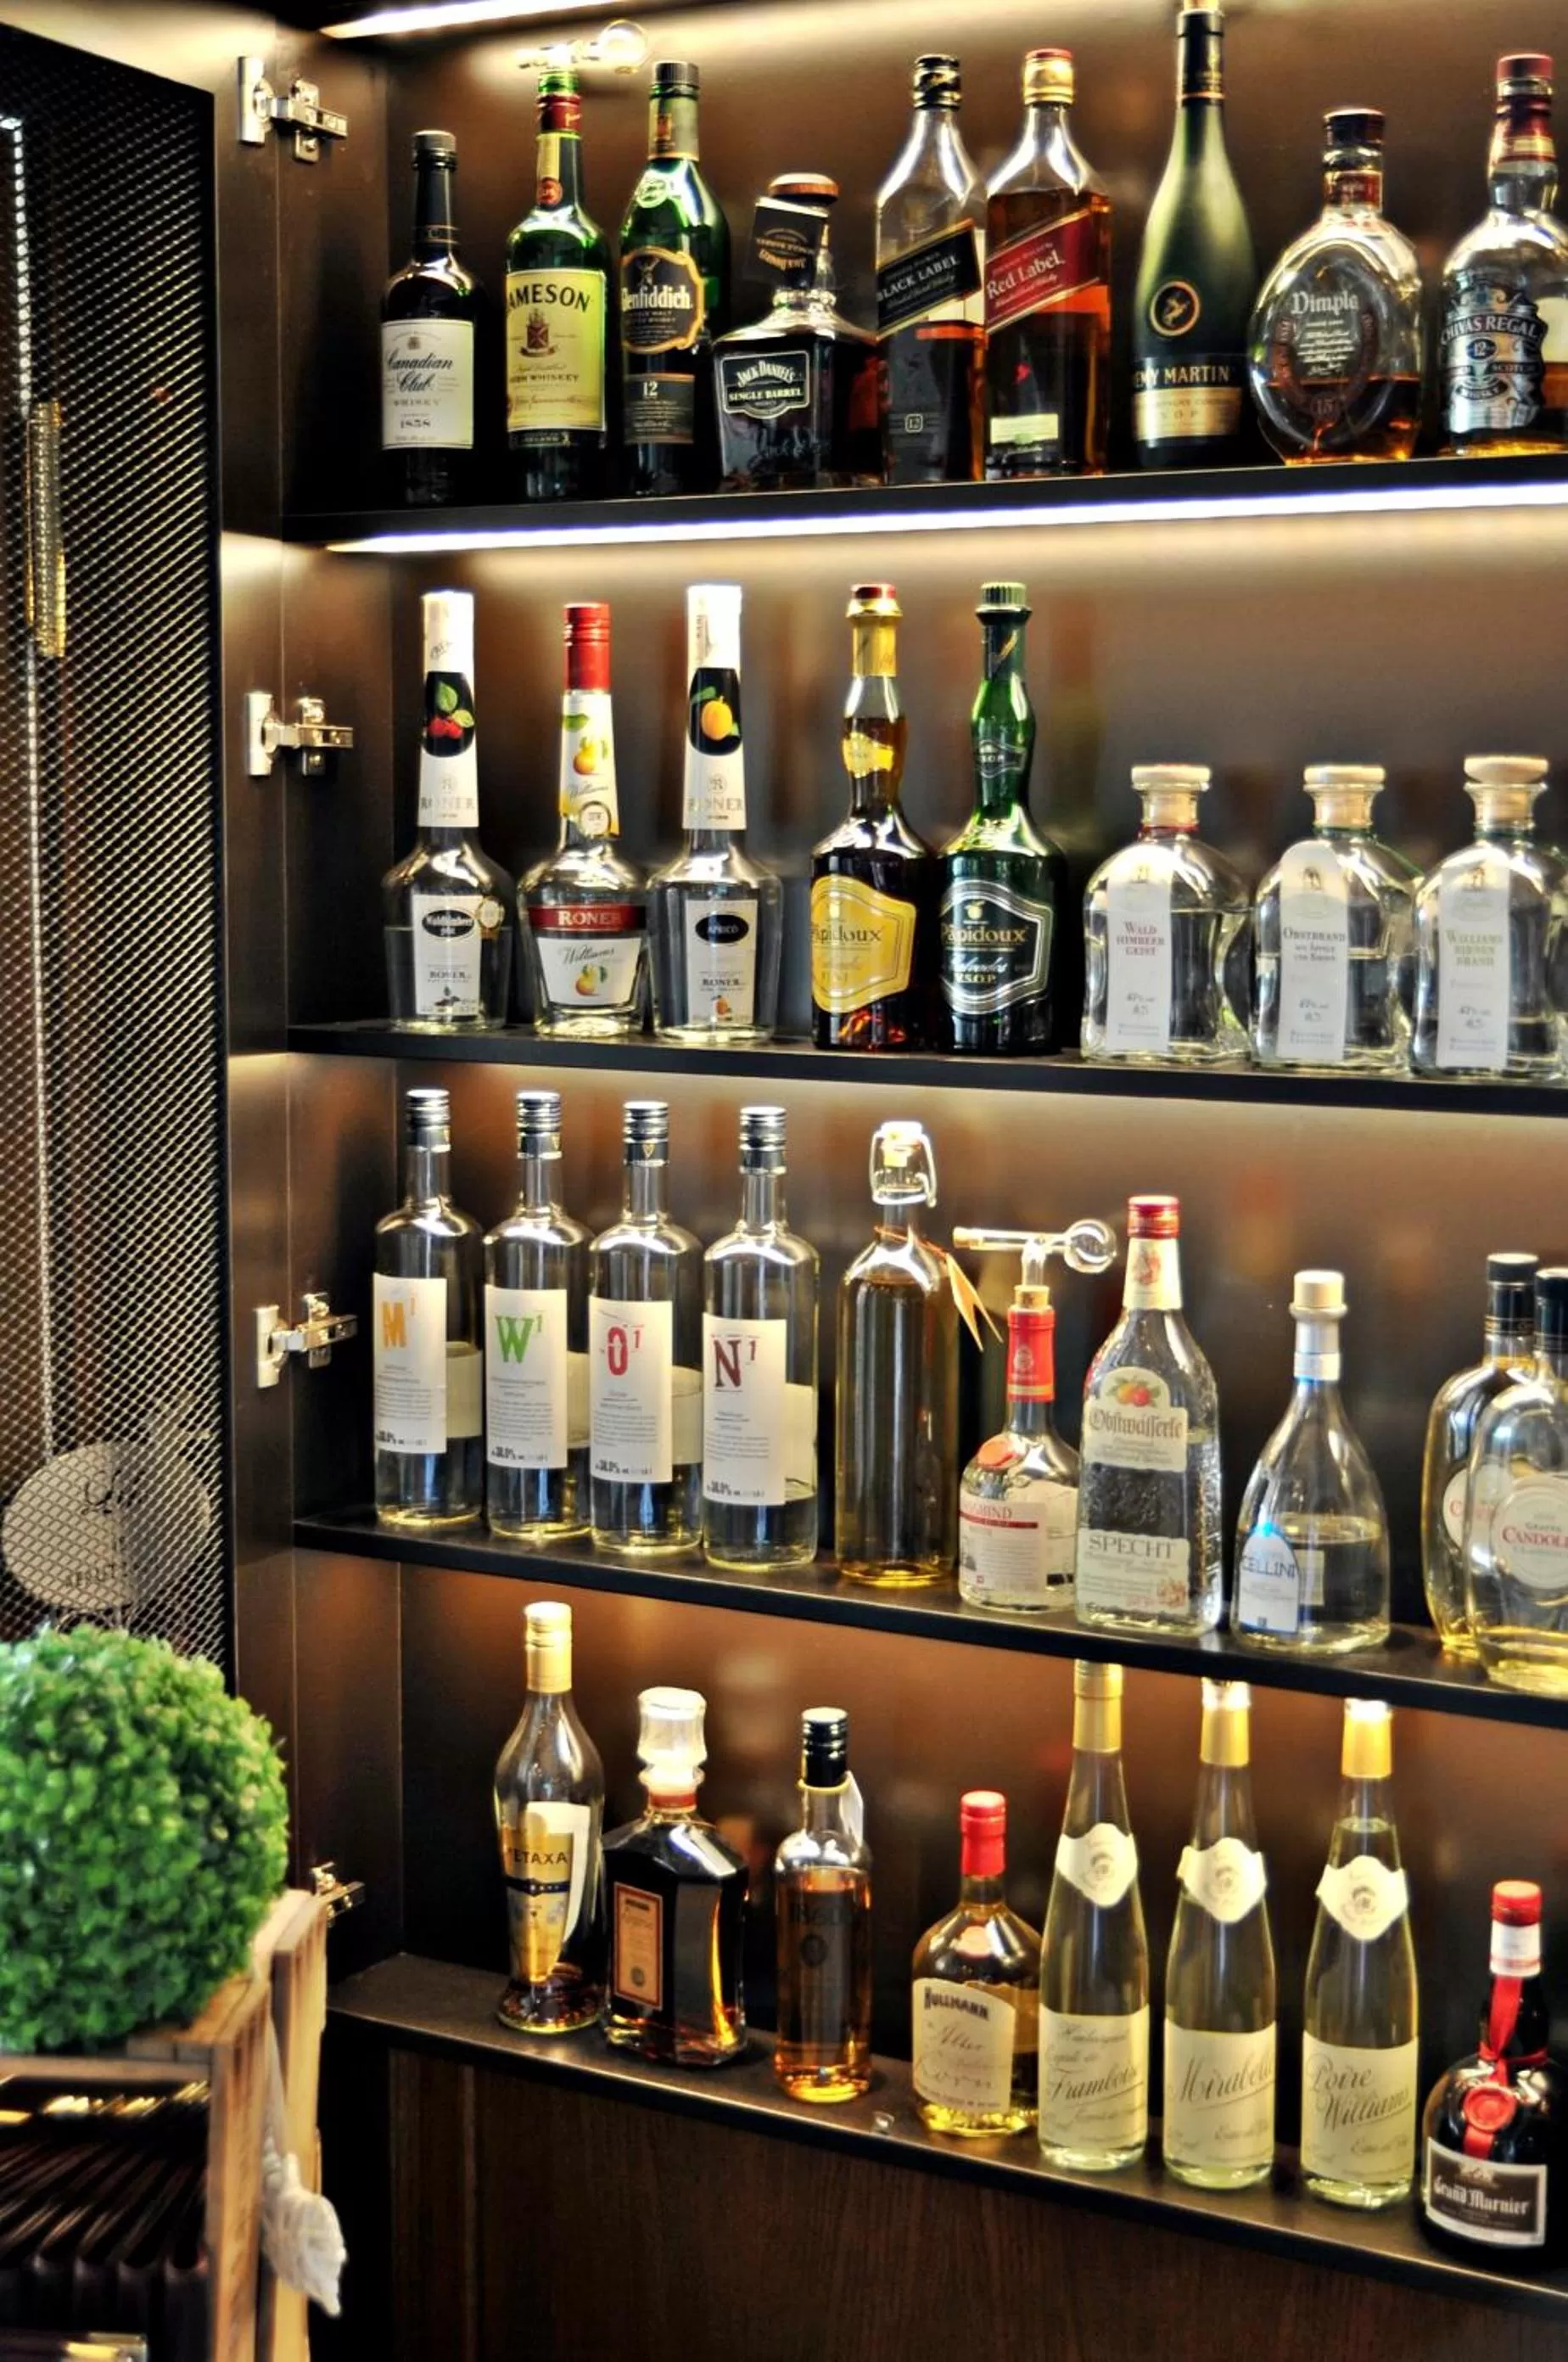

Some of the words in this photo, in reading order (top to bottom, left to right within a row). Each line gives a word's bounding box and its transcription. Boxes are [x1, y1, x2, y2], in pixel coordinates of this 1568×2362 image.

[876, 274, 916, 302] BLACK
[918, 255, 960, 281] LABEL
[987, 272, 1017, 299] Red
[508, 283, 591, 313] AMESON
[1291, 290, 1359, 316] Dimple
[1485, 315, 1537, 338] REGAL
[387, 347, 454, 370] Canadian
[397, 371, 436, 393] Club
[1163, 364, 1230, 384] MARTIN
[642, 382, 658, 396] 12
[557, 909, 624, 927] RONER
[507, 1846, 568, 1865] ETAXA
